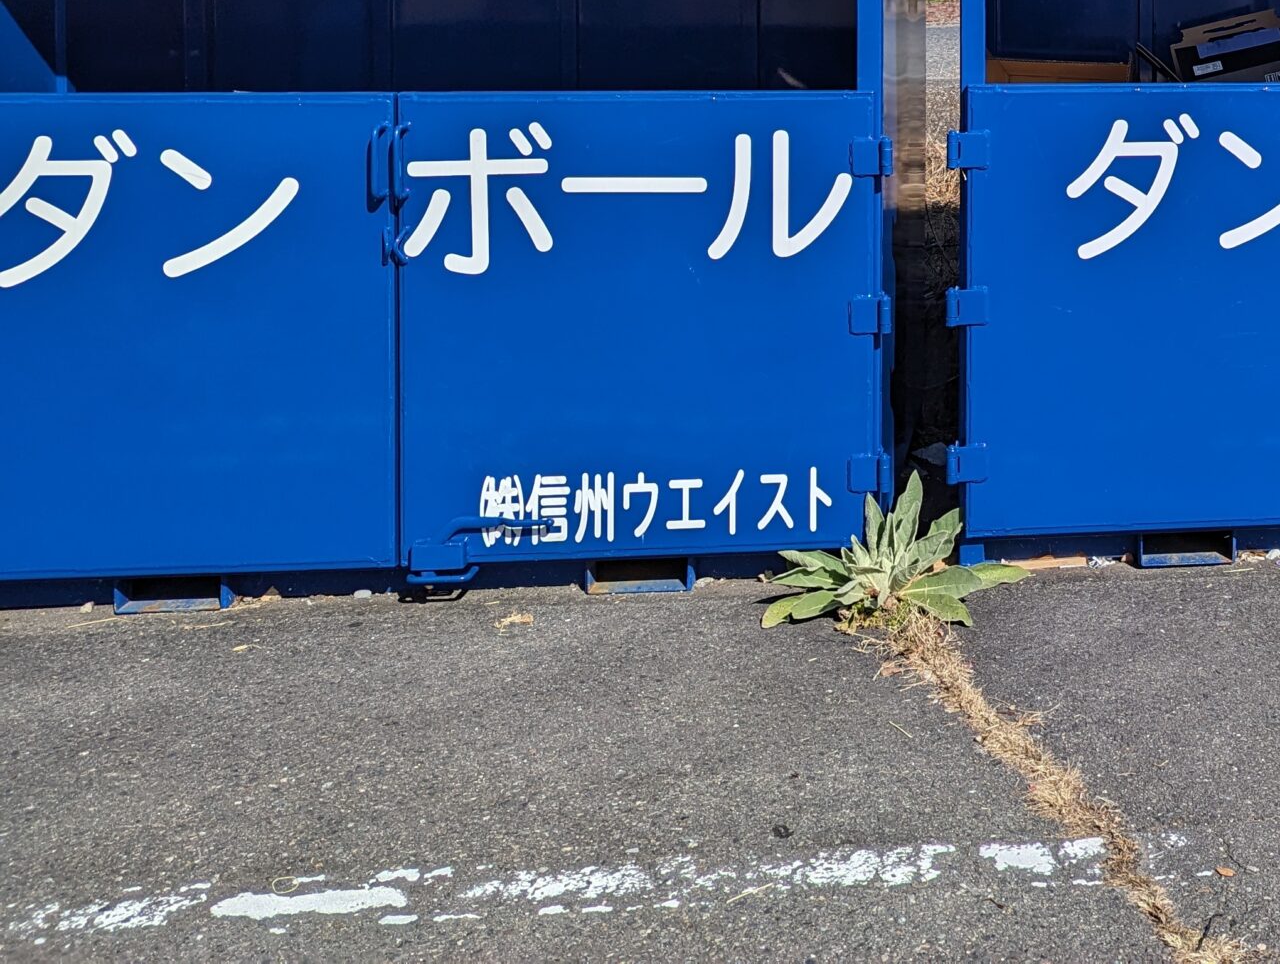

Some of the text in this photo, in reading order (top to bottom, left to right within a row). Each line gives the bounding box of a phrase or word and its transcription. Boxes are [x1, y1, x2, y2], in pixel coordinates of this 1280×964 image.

[0, 123, 853, 288] ダンボール
